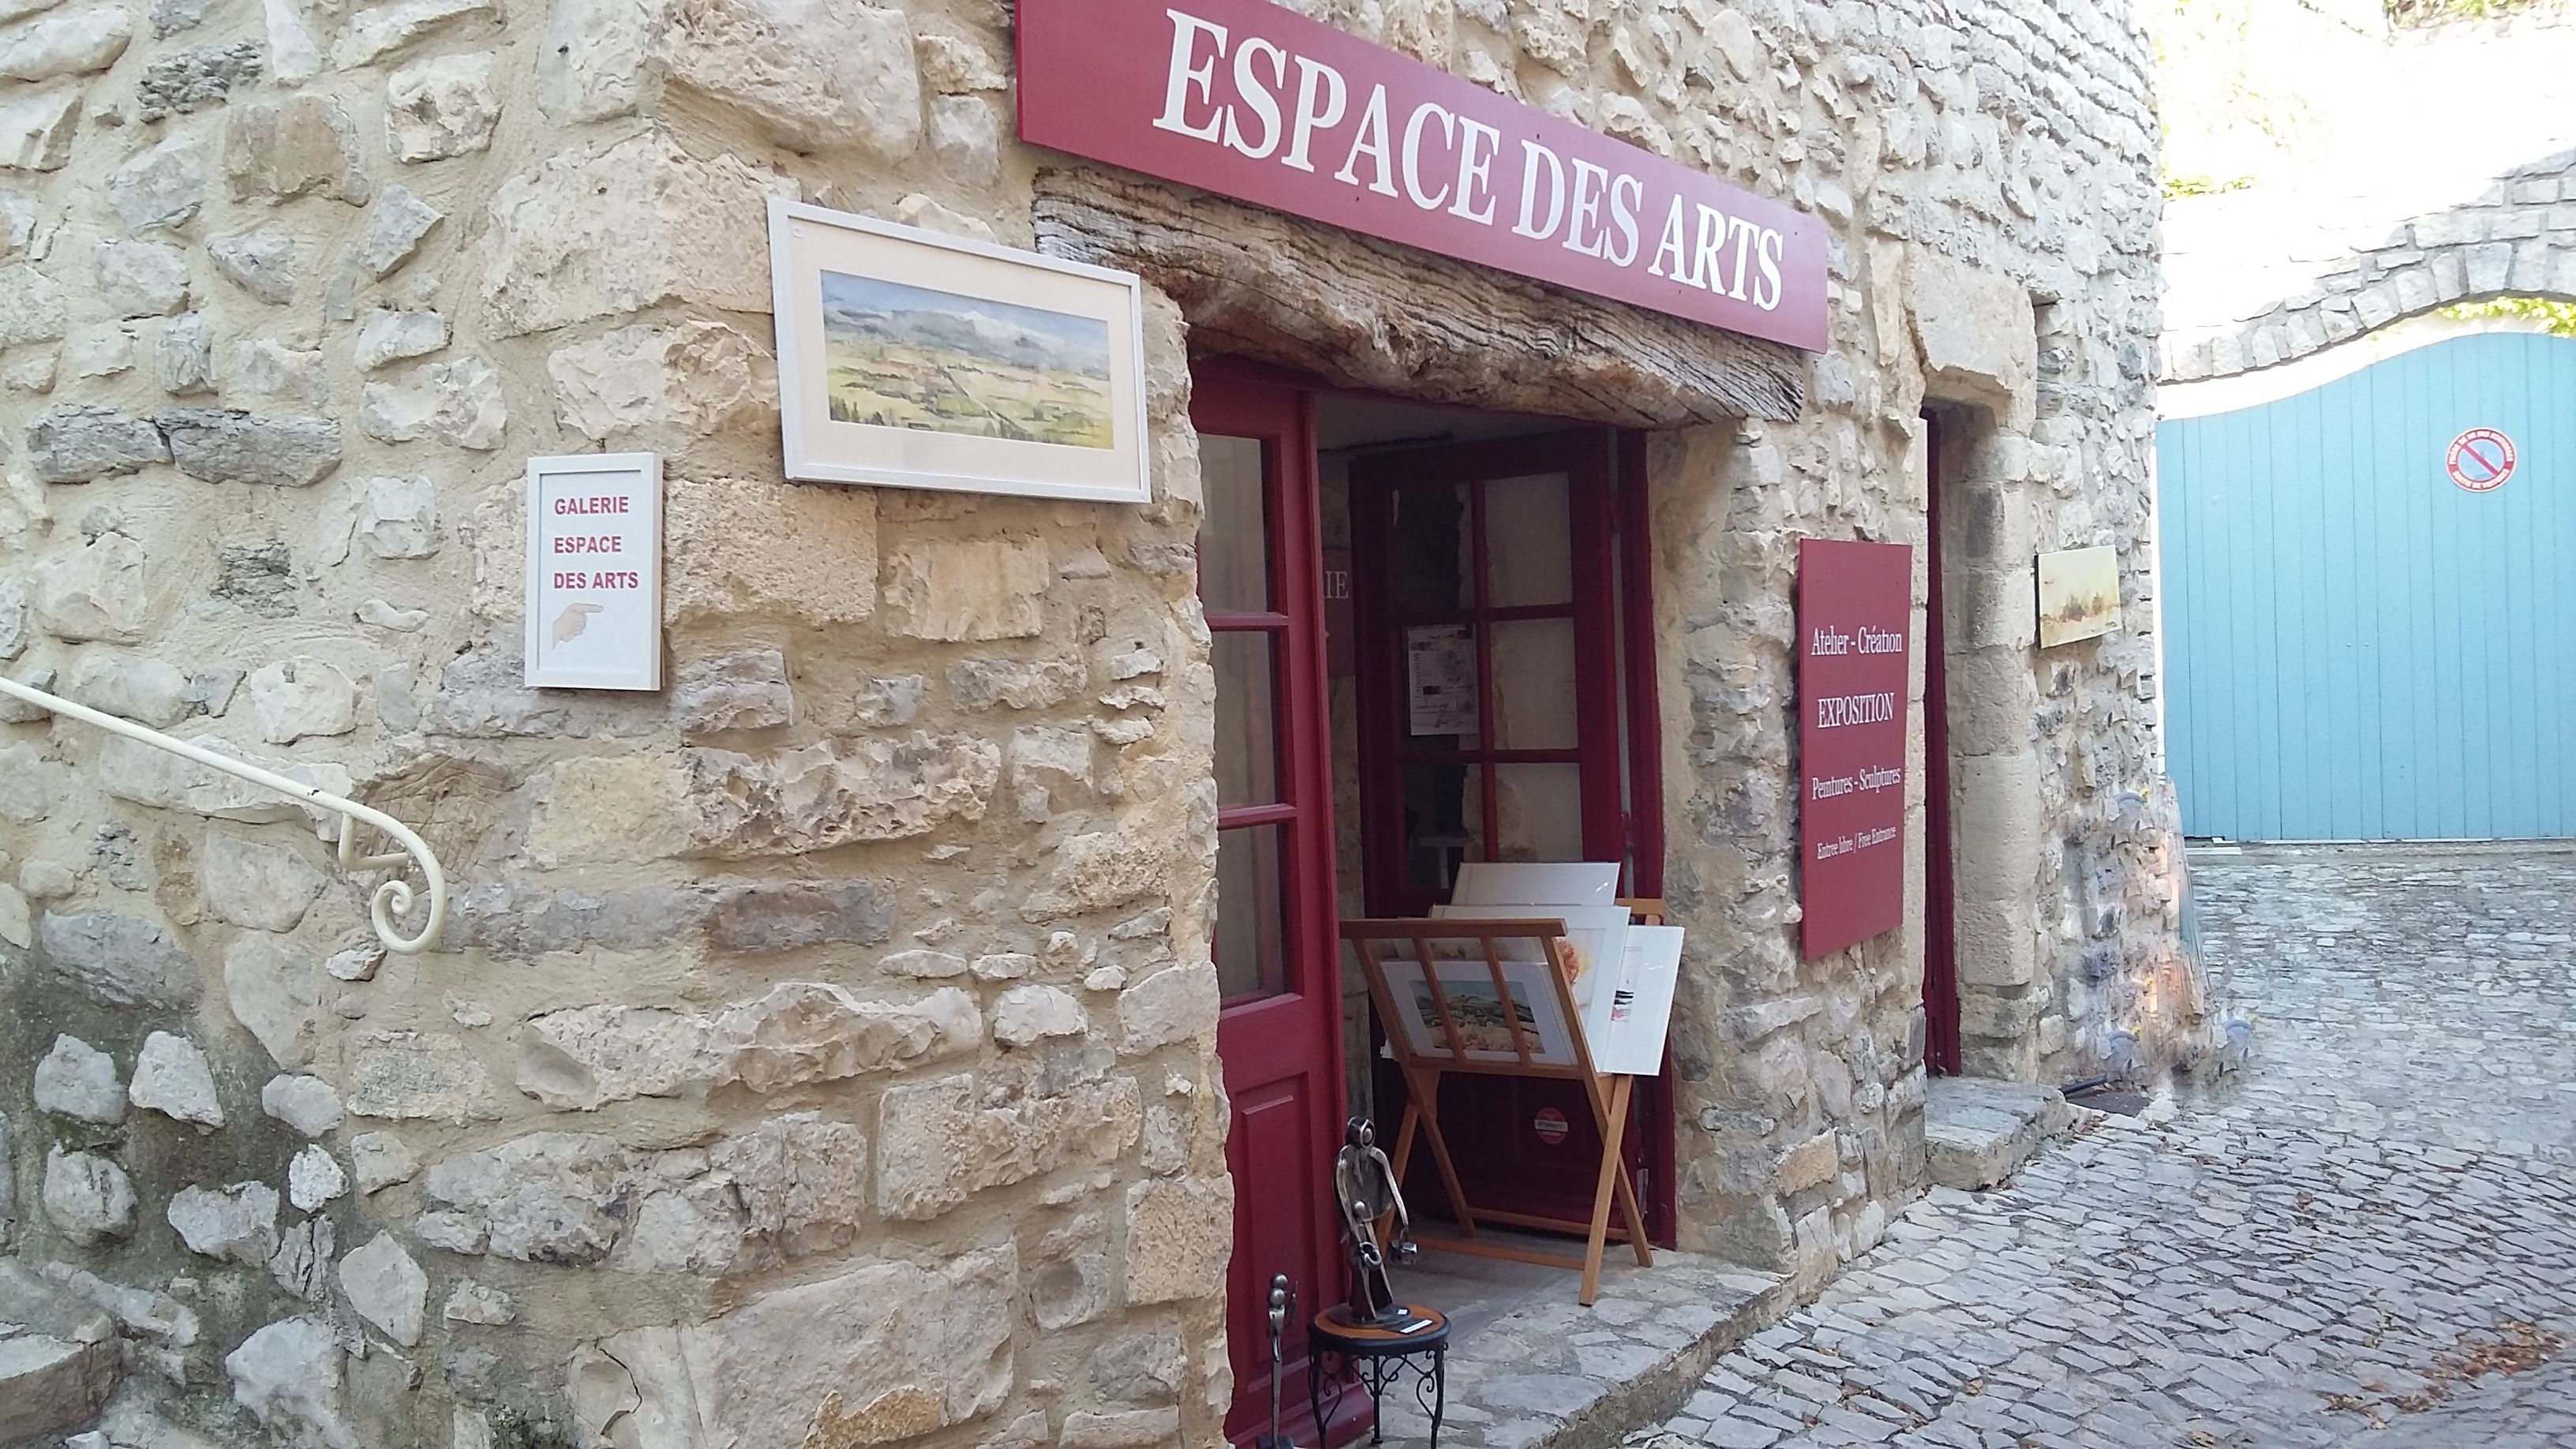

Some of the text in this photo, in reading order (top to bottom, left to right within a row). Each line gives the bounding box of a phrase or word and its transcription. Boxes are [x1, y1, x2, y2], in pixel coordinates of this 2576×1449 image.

[1152, 8, 1784, 312] ESPACE DES ARTS
[554, 496, 629, 515] GALERIE
[554, 536, 622, 553] ESPACE
[553, 571, 638, 590] DES ARTS
[1810, 625, 1849, 656] Atelier
[1857, 624, 1903, 654] Création
[1817, 691, 1895, 728] EXPOSITION
[1811, 776, 1853, 801] Peintures
[1859, 765, 1901, 794] Sculptures
[1838, 835, 1853, 855] libre
[1858, 832, 1871, 850] Free
[1871, 826, 1897, 845] Entrance
